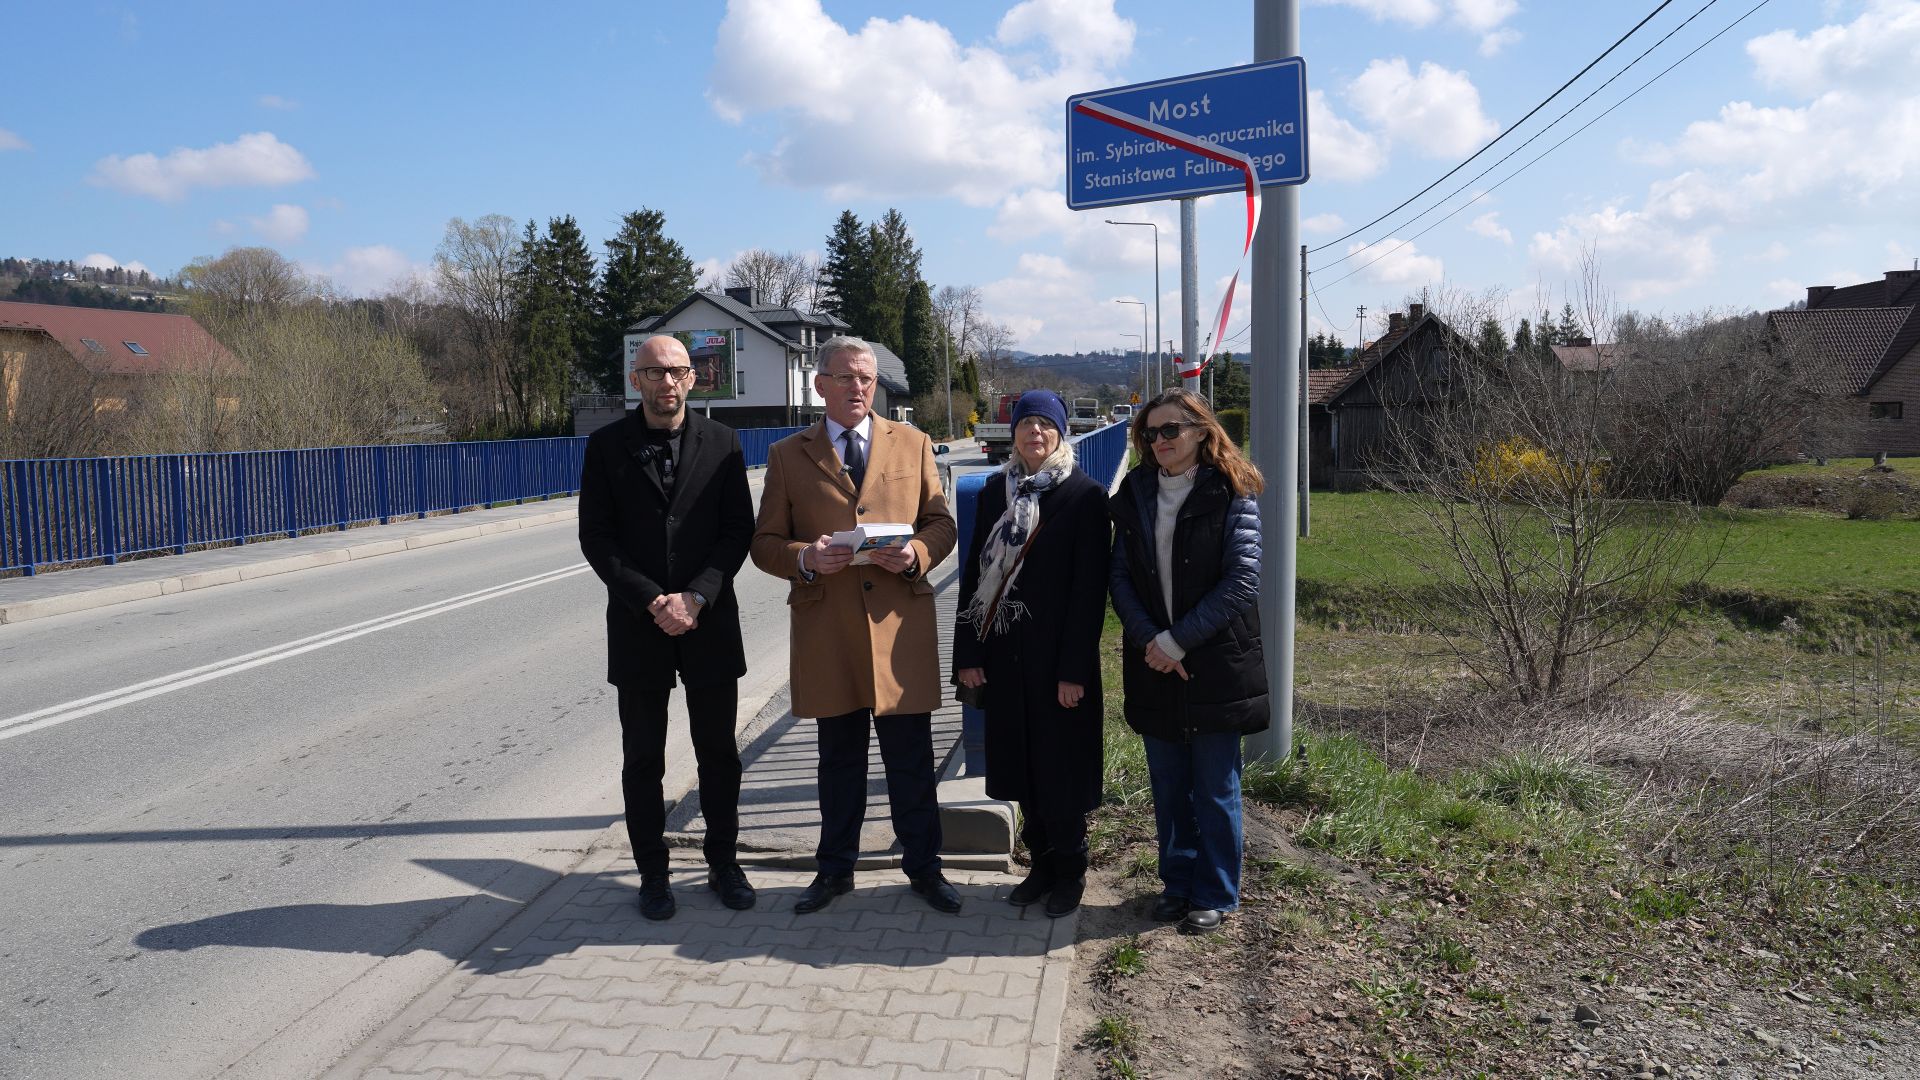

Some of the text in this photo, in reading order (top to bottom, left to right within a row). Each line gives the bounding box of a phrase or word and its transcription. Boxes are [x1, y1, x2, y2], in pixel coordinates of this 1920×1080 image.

[1149, 92, 1212, 123] Most
[1076, 148, 1100, 163] im.
[1105, 139, 1177, 162] Sybiraka
[1085, 166, 1176, 190] Stanisława
[706, 337, 725, 345] JULA
